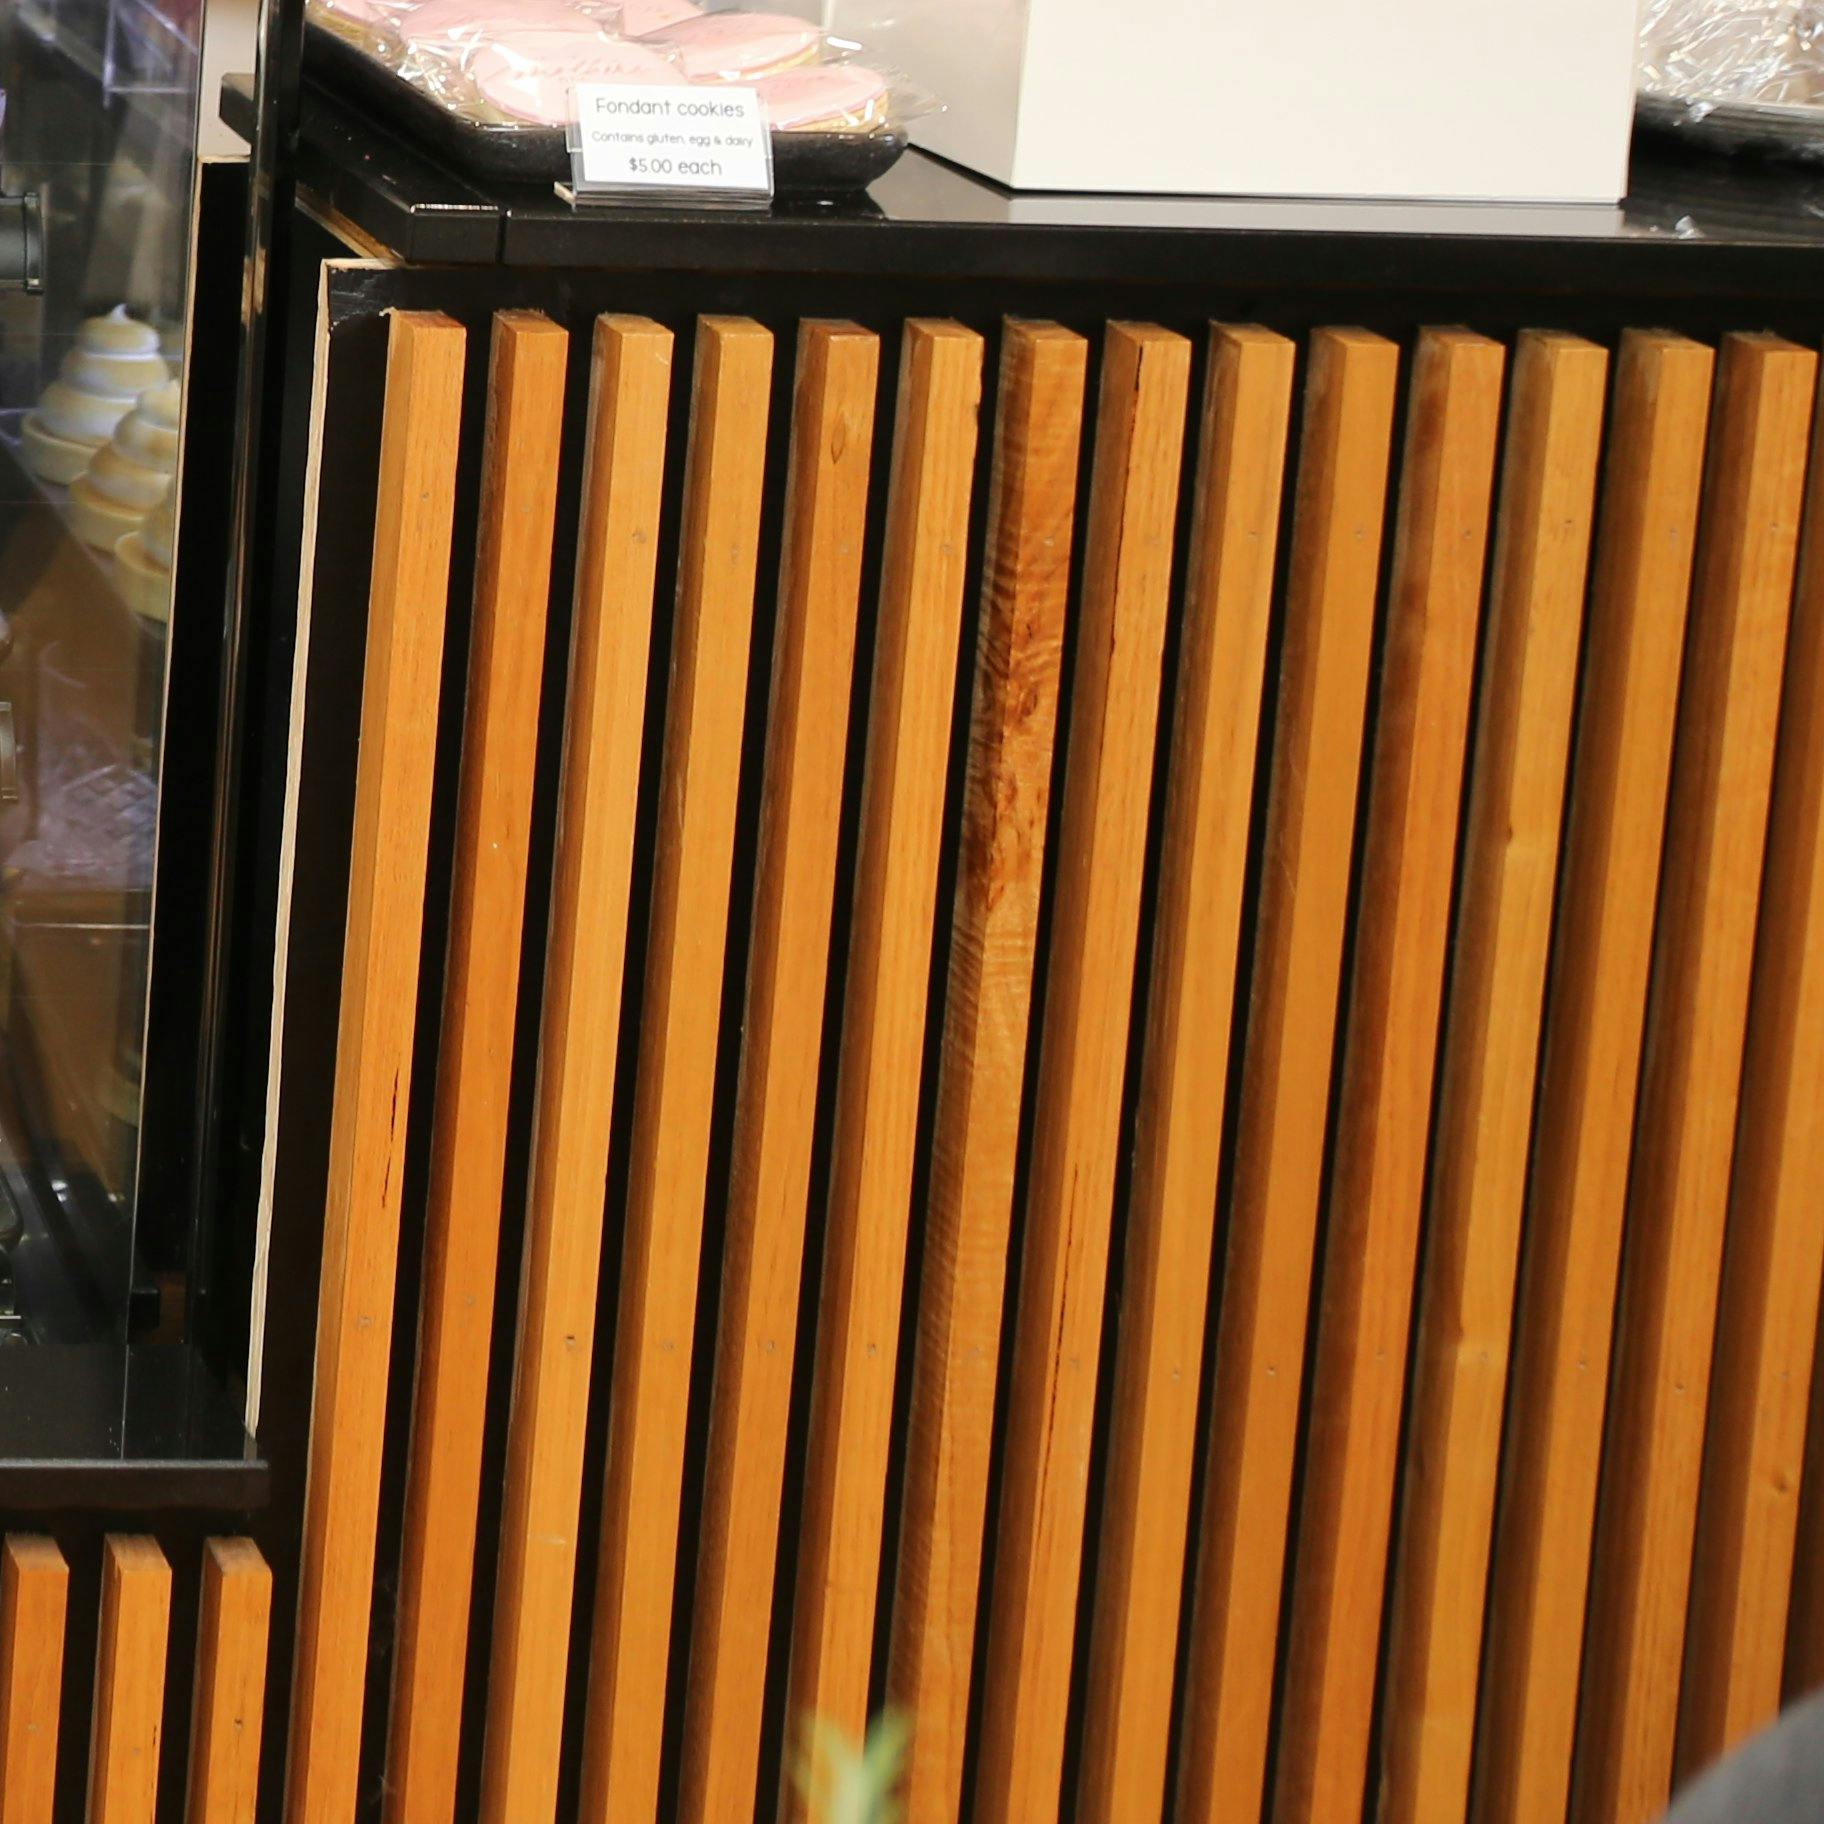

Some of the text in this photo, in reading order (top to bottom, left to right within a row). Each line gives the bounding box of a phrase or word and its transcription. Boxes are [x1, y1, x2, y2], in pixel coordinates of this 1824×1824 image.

[596, 97, 745, 118] Fondant cookies
[591, 131, 643, 143] Contains
[688, 136, 711, 147] egg
[714, 135, 721, 145] &
[727, 135, 754, 148] dairy
[629, 157, 722, 176] $5.00 each
